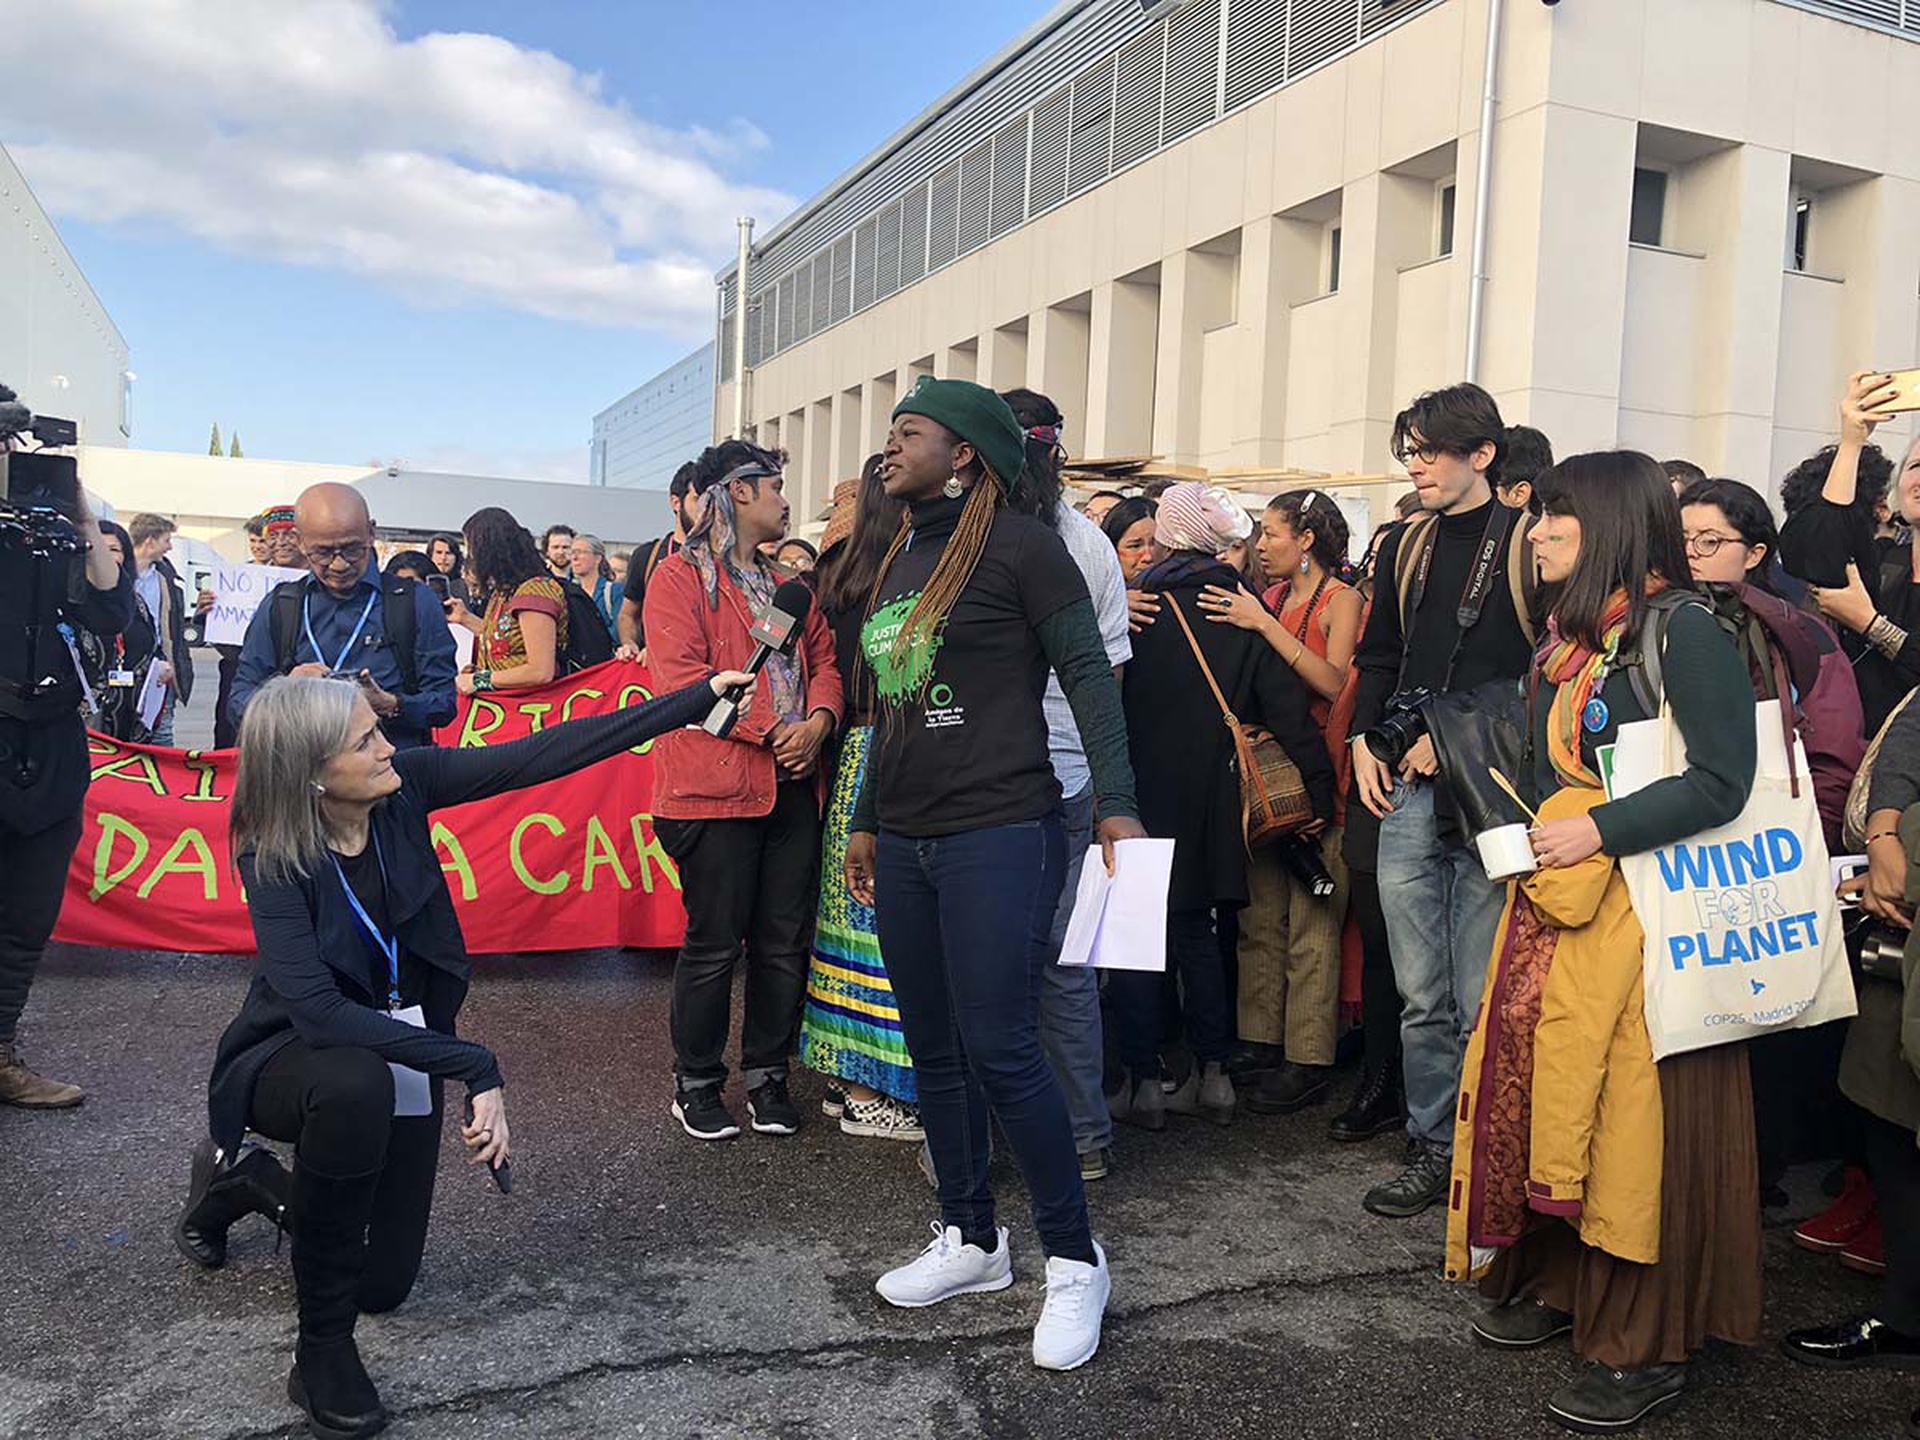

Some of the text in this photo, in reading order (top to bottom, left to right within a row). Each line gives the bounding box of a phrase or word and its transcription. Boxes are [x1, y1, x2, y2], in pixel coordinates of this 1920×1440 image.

[218, 570, 254, 593] NO
[1469, 539, 1496, 600] EOS DIGITAL
[1654, 827, 1803, 892] WIND
[1693, 879, 1787, 929] FOR
[1667, 910, 1820, 971] PLANET
[1703, 1012, 1746, 1027] COP25
[1753, 1005, 1794, 1022] Madrid
